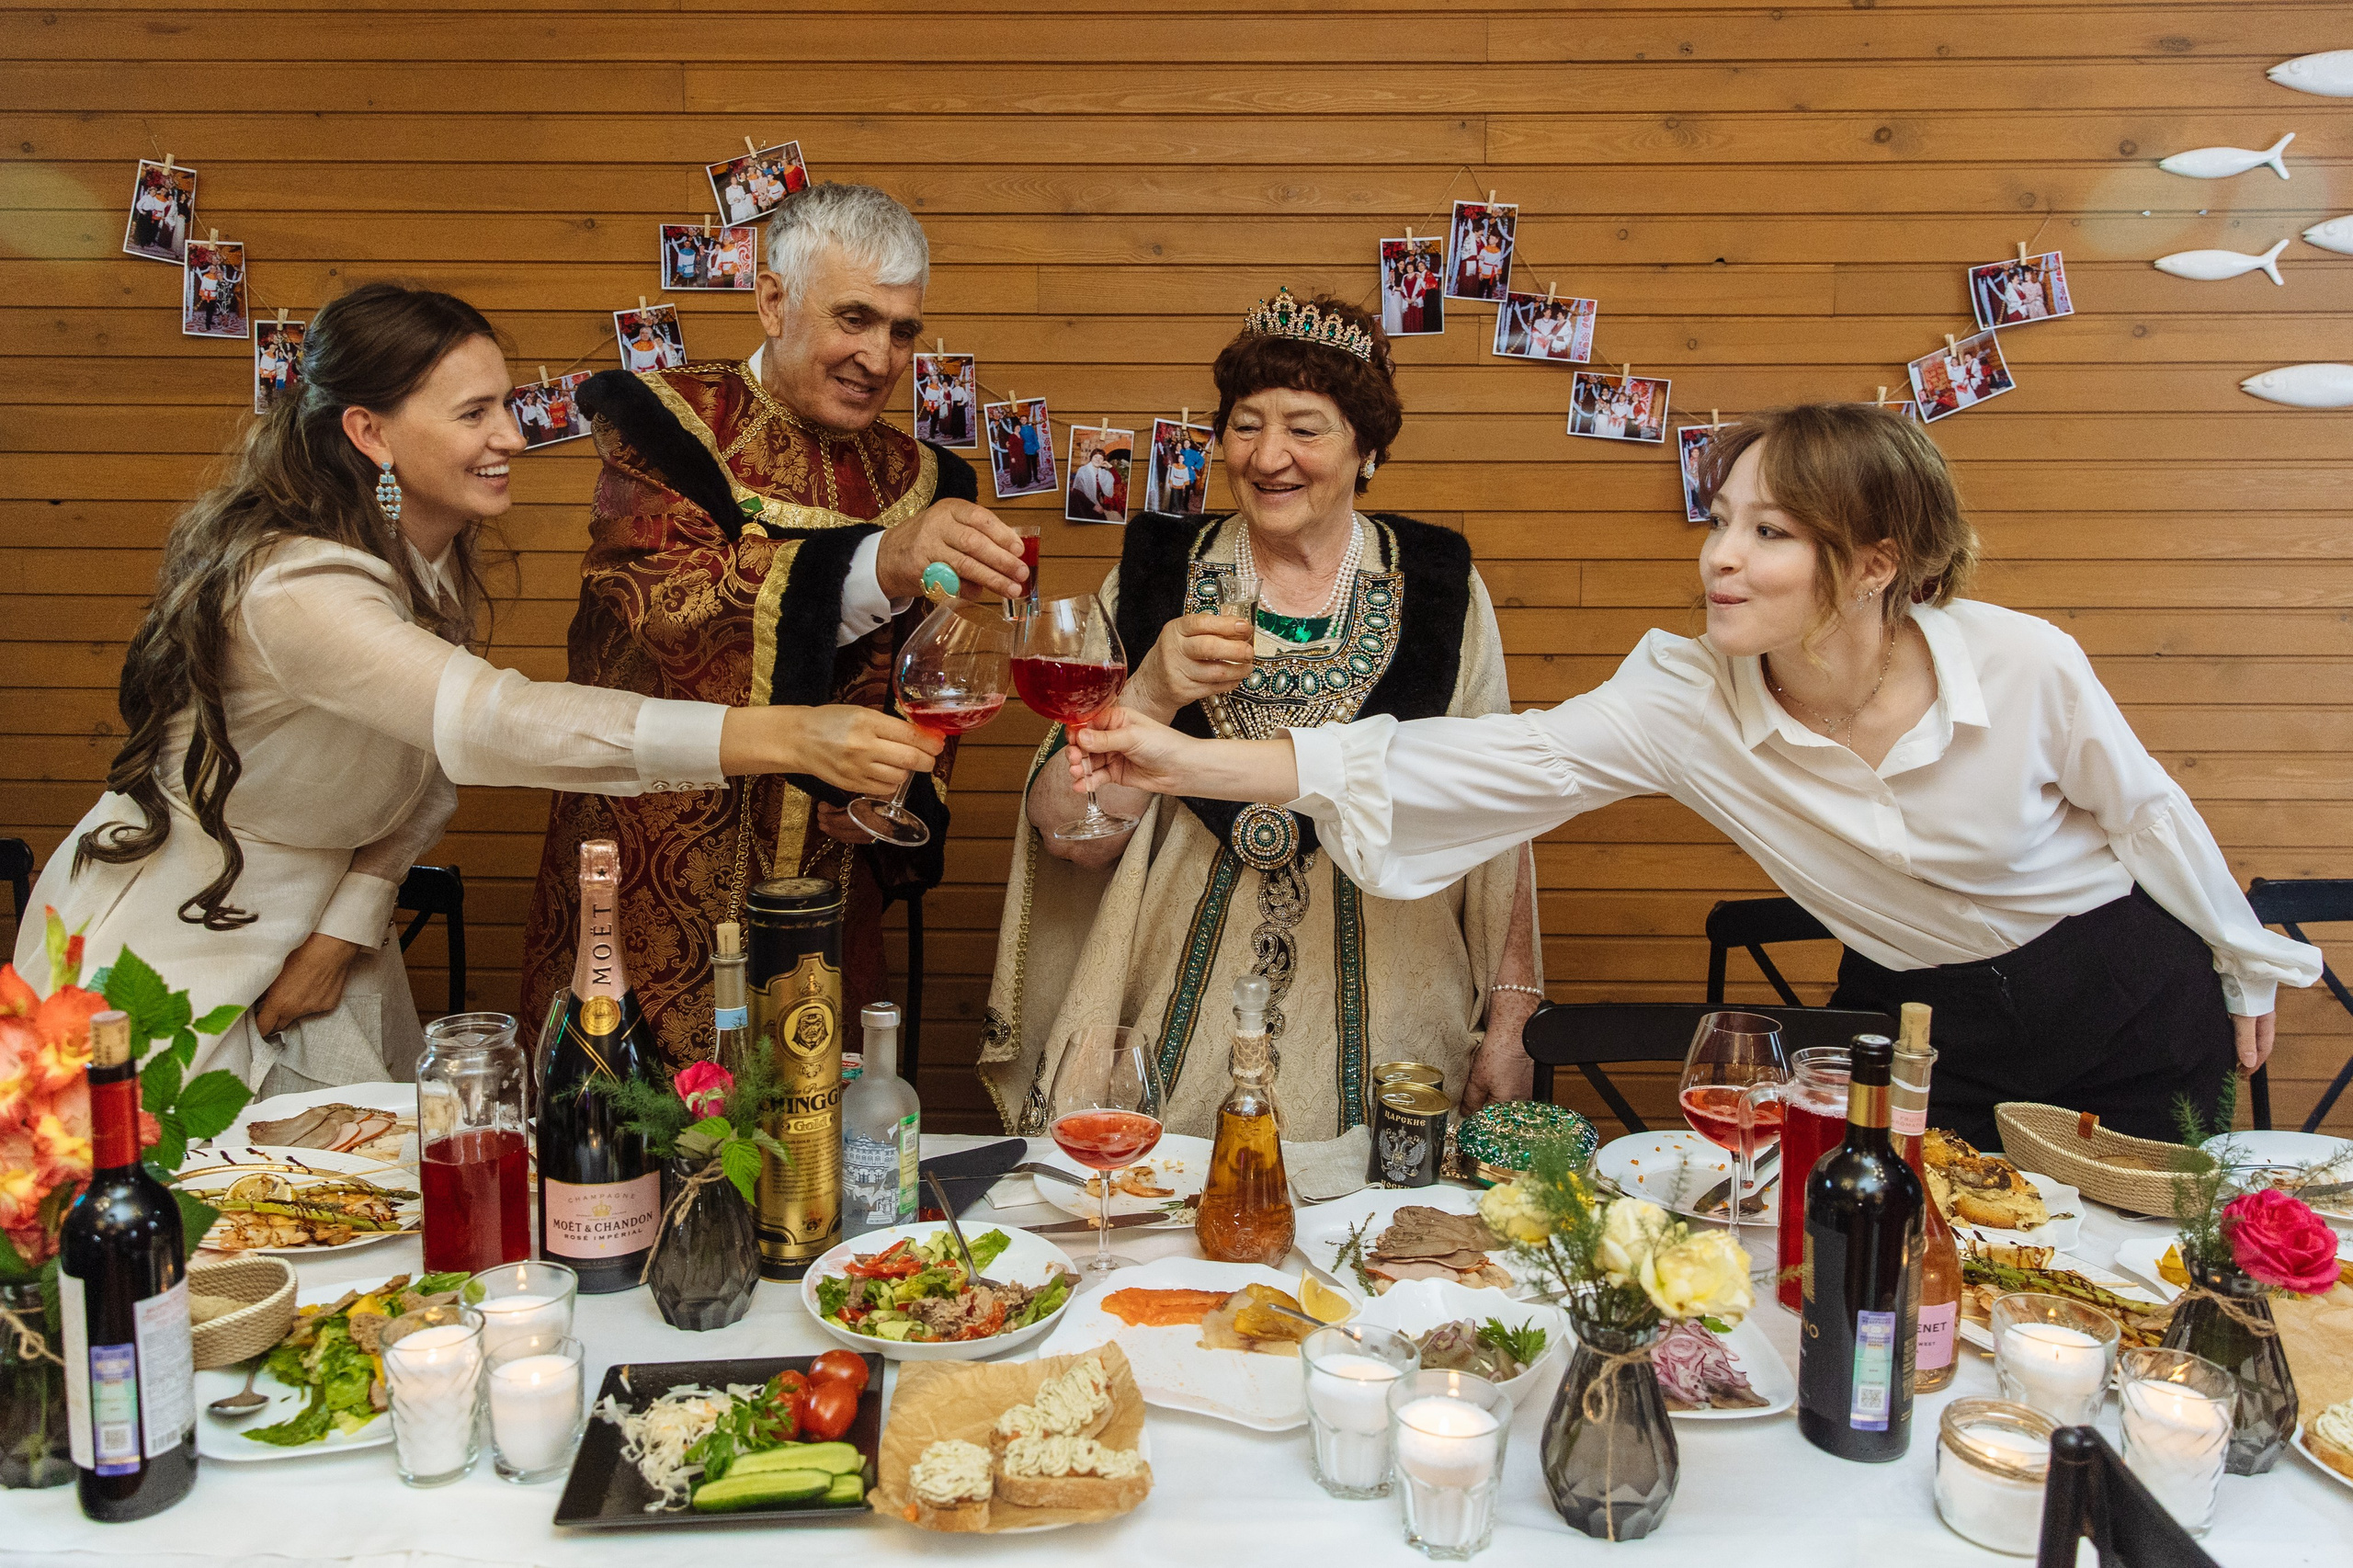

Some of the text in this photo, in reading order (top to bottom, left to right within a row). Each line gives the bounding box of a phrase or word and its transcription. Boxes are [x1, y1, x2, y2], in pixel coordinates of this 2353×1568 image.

[591, 903, 612, 985] MOËT
[793, 1116, 828, 1131] Gold
[1384, 1109, 1427, 1127] ЦАРСКИЕ
[567, 1193, 635, 1203] CHAMPAGNE
[553, 1210, 654, 1233] MOËT & CHANDON
[593, 1228, 643, 1241] IMPÉRIAL
